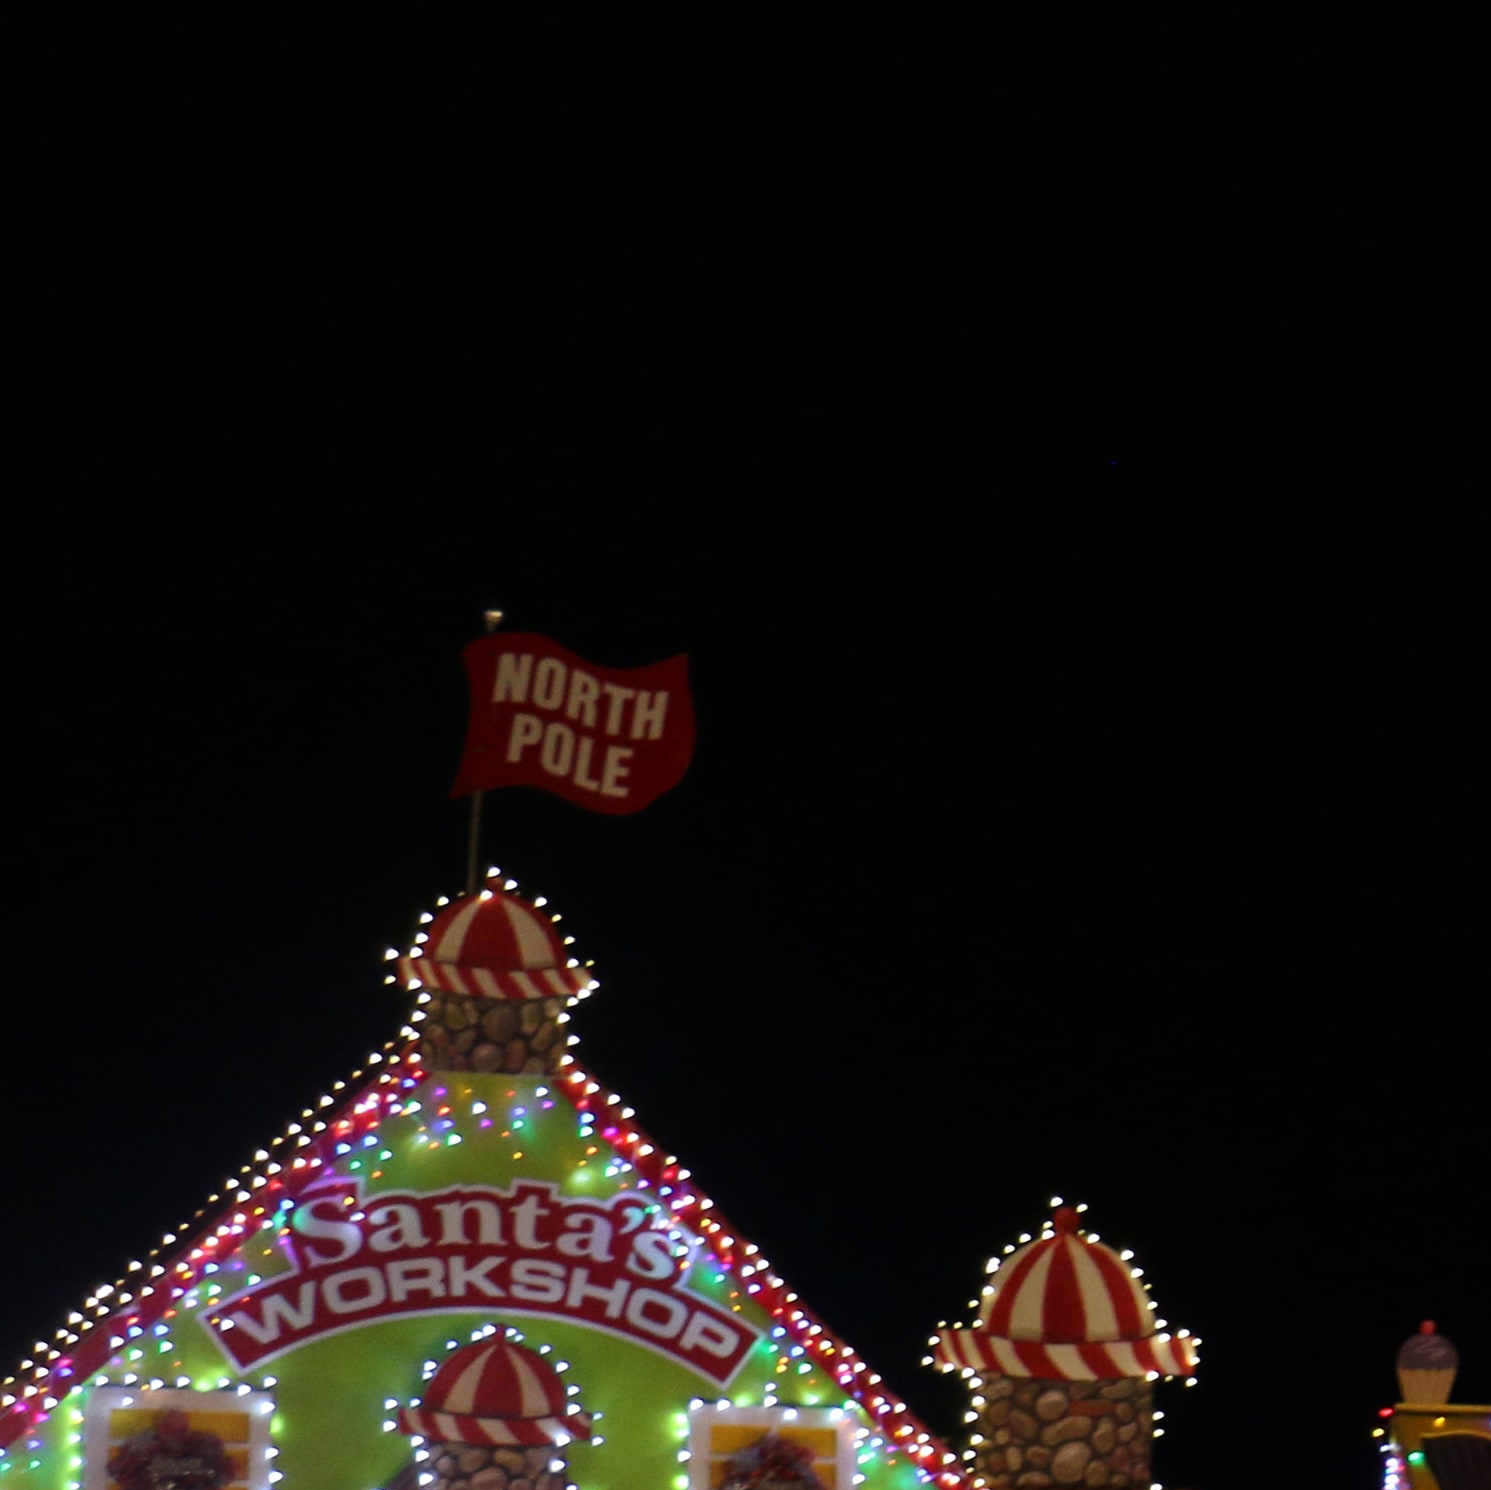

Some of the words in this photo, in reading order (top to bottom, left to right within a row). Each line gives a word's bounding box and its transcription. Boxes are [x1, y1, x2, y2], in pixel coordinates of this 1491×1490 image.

[493, 653, 669, 740] NORTH
[506, 713, 634, 797] POLE
[294, 1193, 690, 1281] Santa's
[234, 1255, 740, 1359] WORKSHOP
